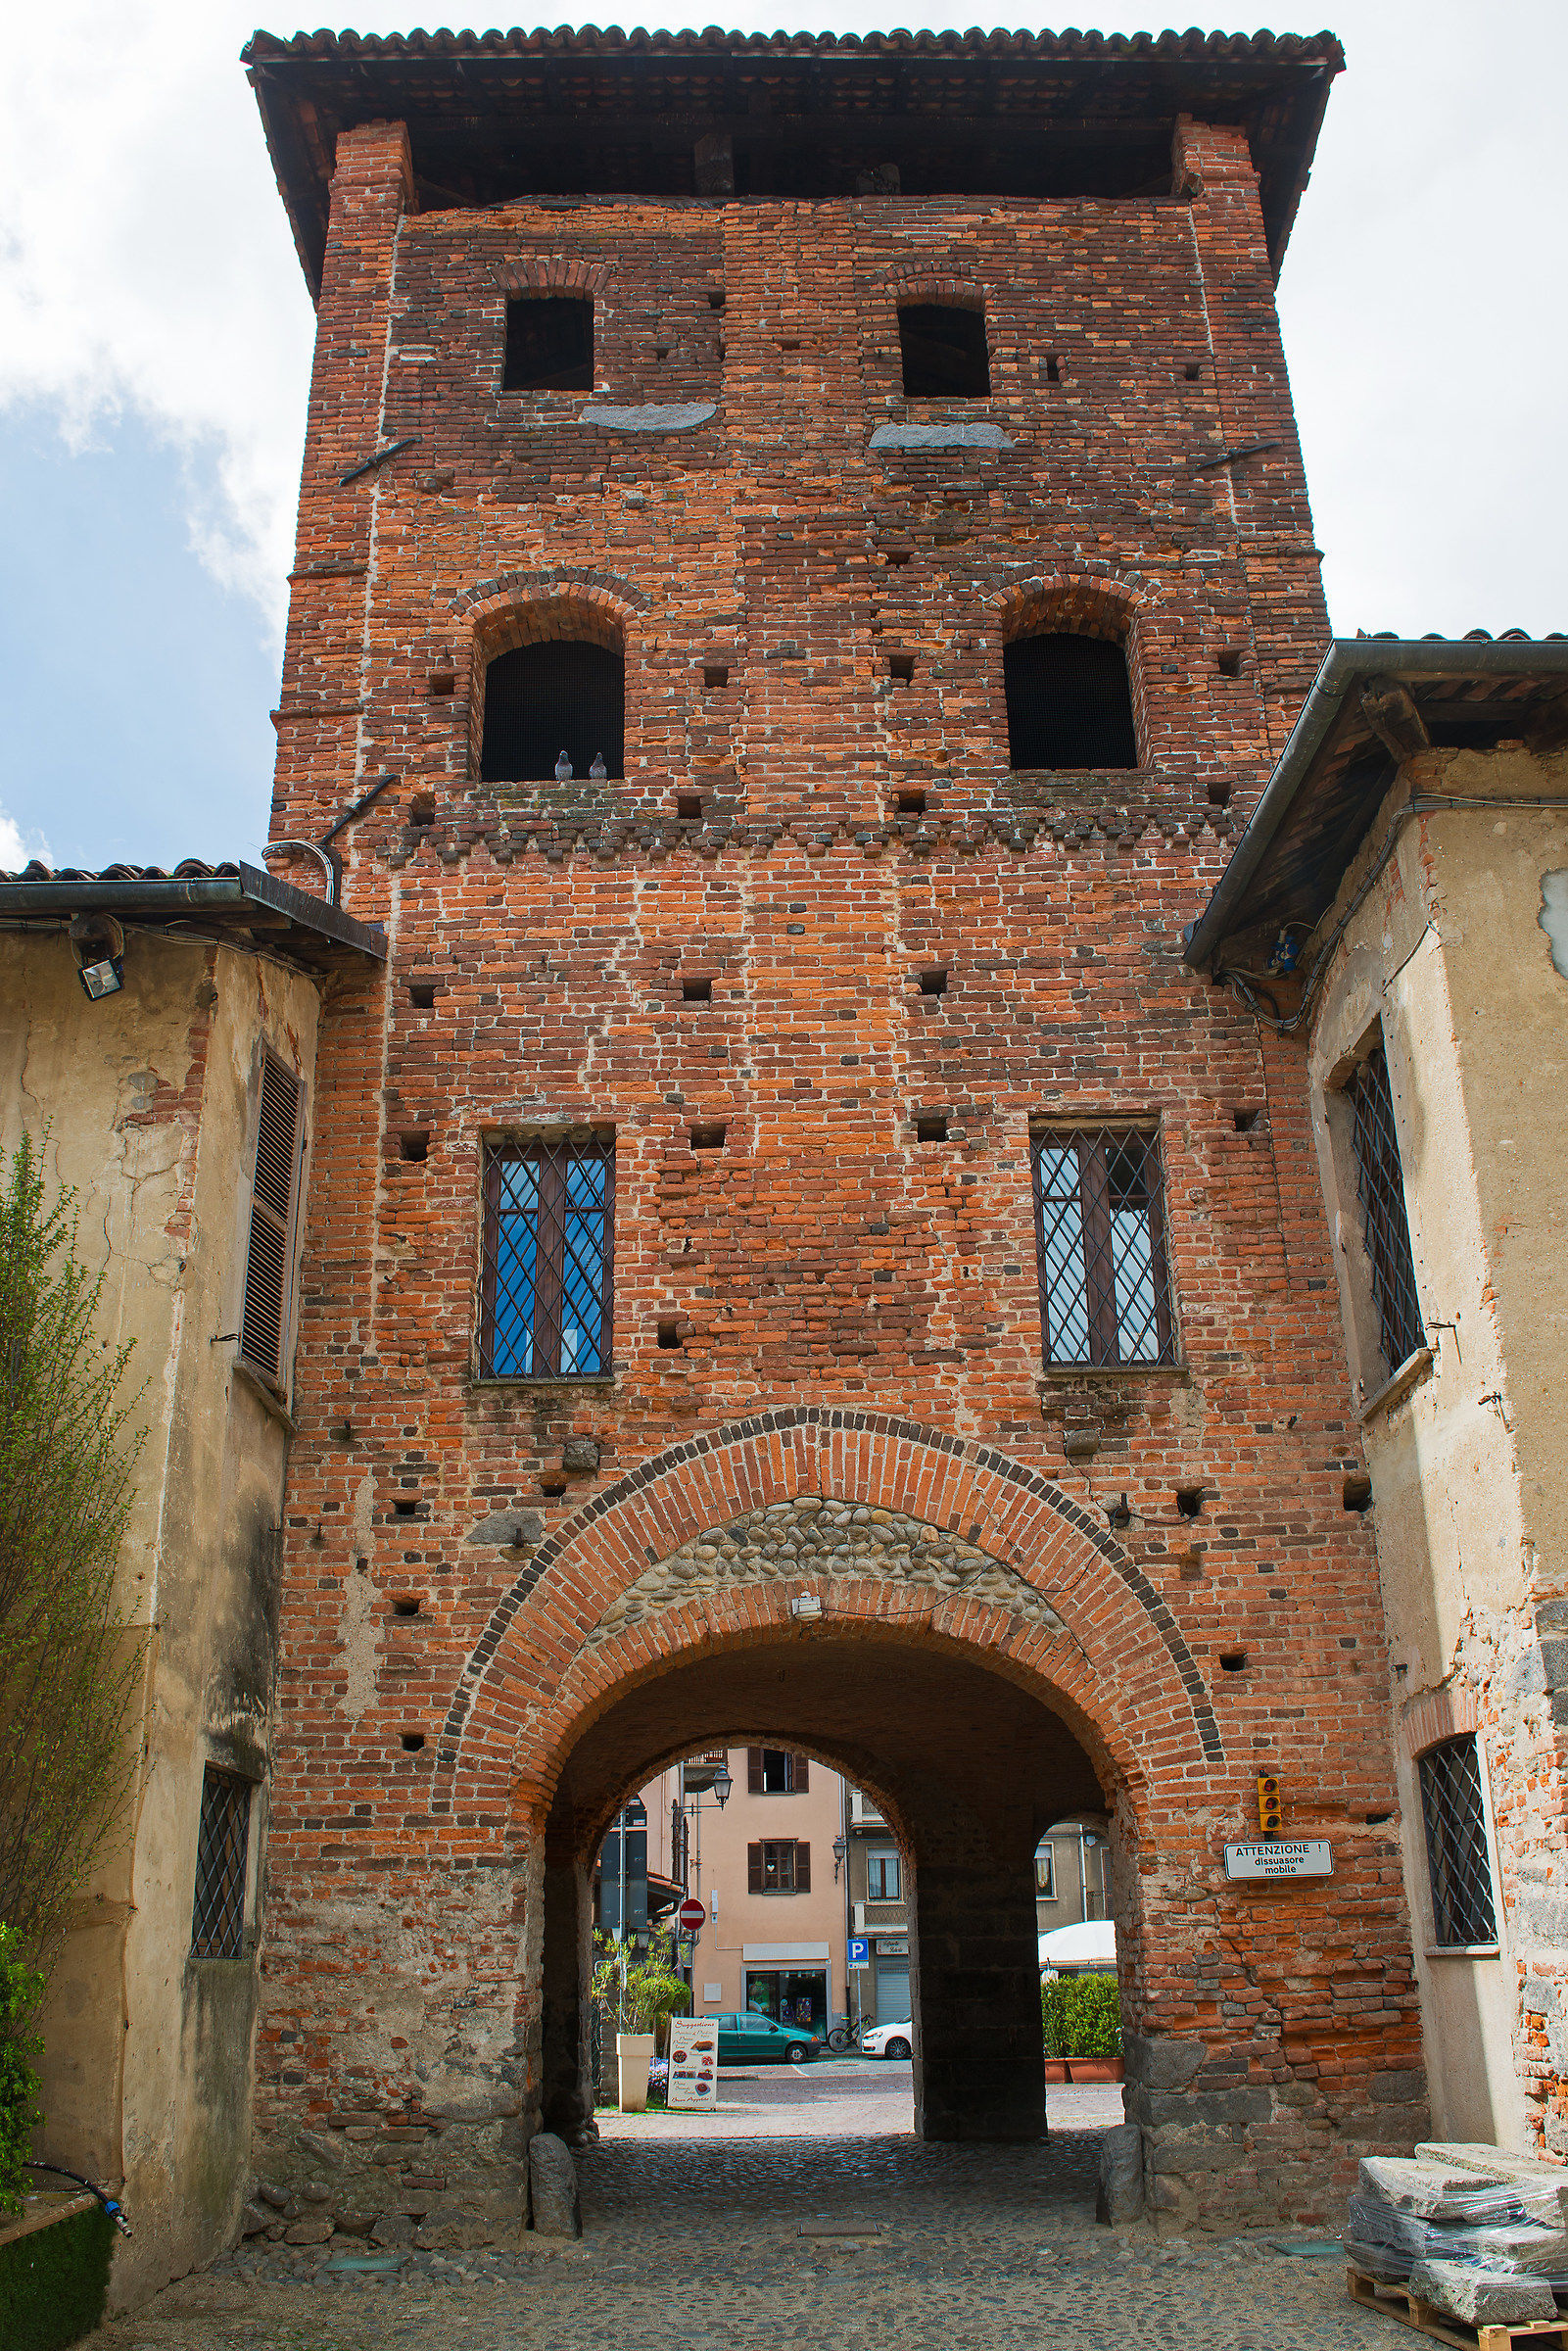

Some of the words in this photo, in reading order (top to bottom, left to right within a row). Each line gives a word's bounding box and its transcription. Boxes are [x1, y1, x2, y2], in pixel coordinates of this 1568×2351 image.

[1236, 1844, 1309, 1856] ATTENZIONE
[1255, 1856, 1304, 1865] dissuasore
[1265, 1865, 1297, 1874] mobile
[852, 1942, 864, 1958] P
